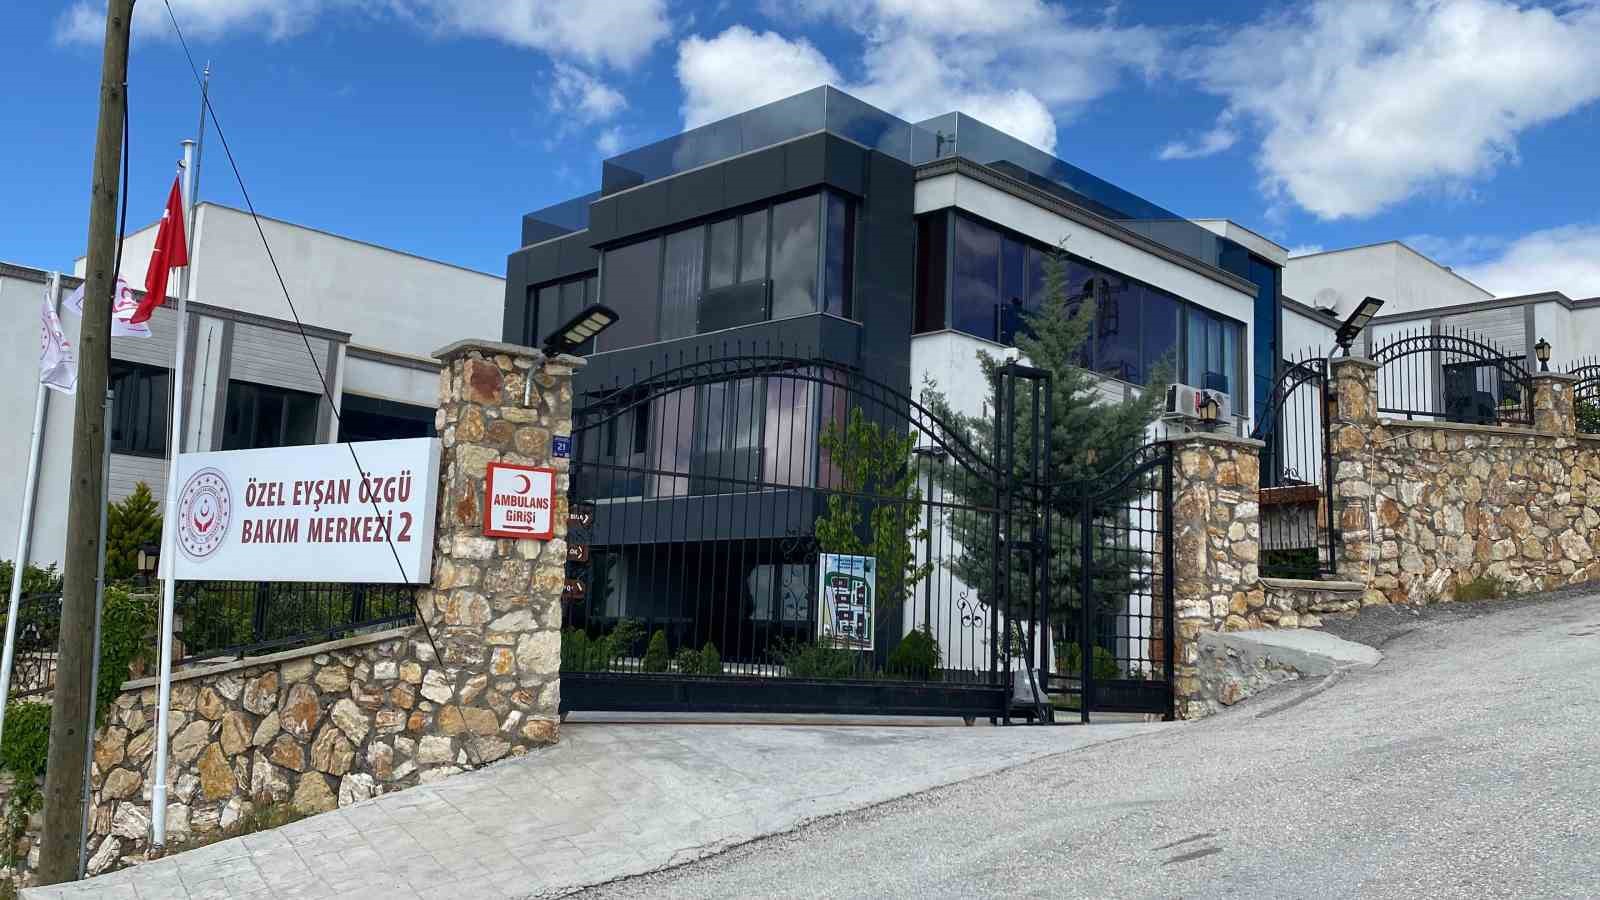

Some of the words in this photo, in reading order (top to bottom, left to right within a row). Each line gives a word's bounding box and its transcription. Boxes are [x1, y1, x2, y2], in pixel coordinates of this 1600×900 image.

[245, 478, 285, 507] ÖZEL
[292, 479, 351, 511] EYŞAN
[358, 470, 411, 503] ÖZGÜ
[494, 494, 549, 510] AMBULANS
[241, 519, 299, 544] BAKIM
[307, 510, 393, 543] MERKEZİ
[396, 512, 412, 541] 2
